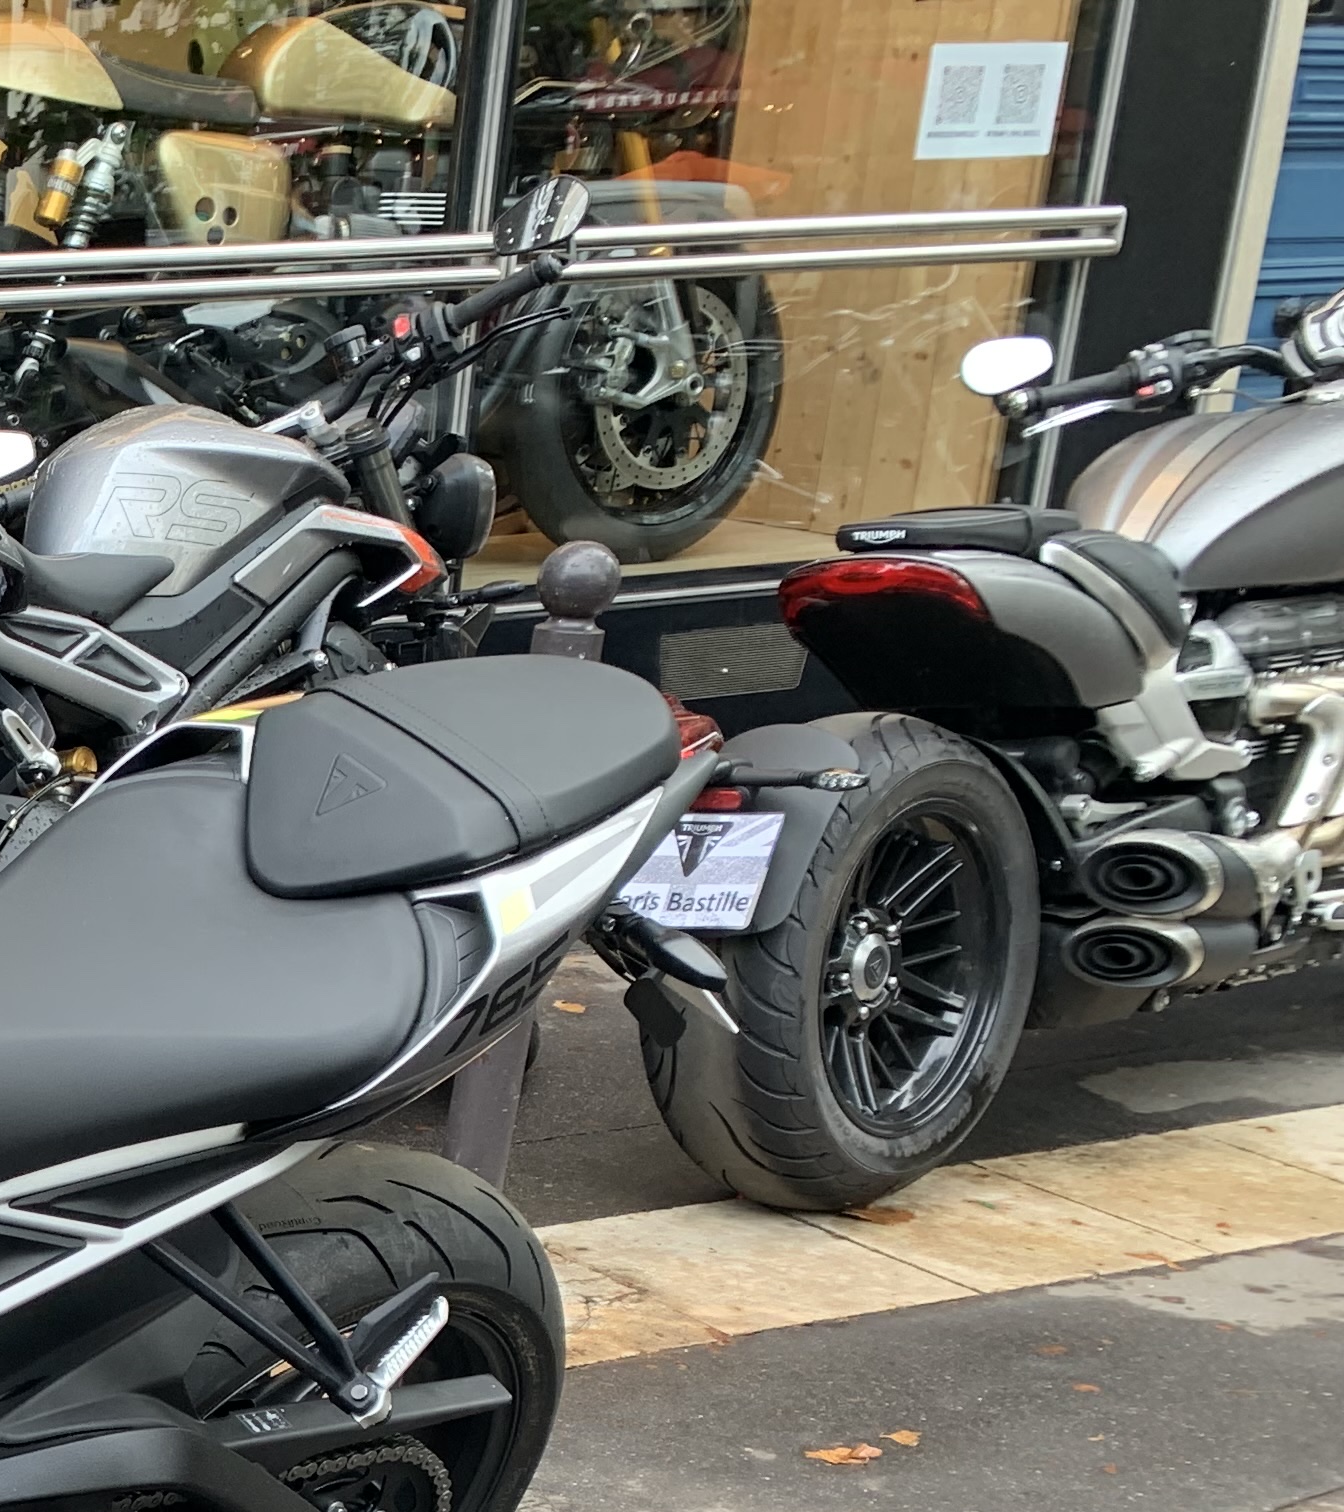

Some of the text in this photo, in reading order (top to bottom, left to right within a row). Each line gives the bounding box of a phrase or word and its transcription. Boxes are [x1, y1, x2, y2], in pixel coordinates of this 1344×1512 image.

[93, 472, 251, 546] RS
[851, 529, 907, 543] TRIUMPH
[681, 823, 724, 834] TRIUMPH
[621, 890, 750, 912] aris Bastille
[443, 929, 570, 1057] 765
